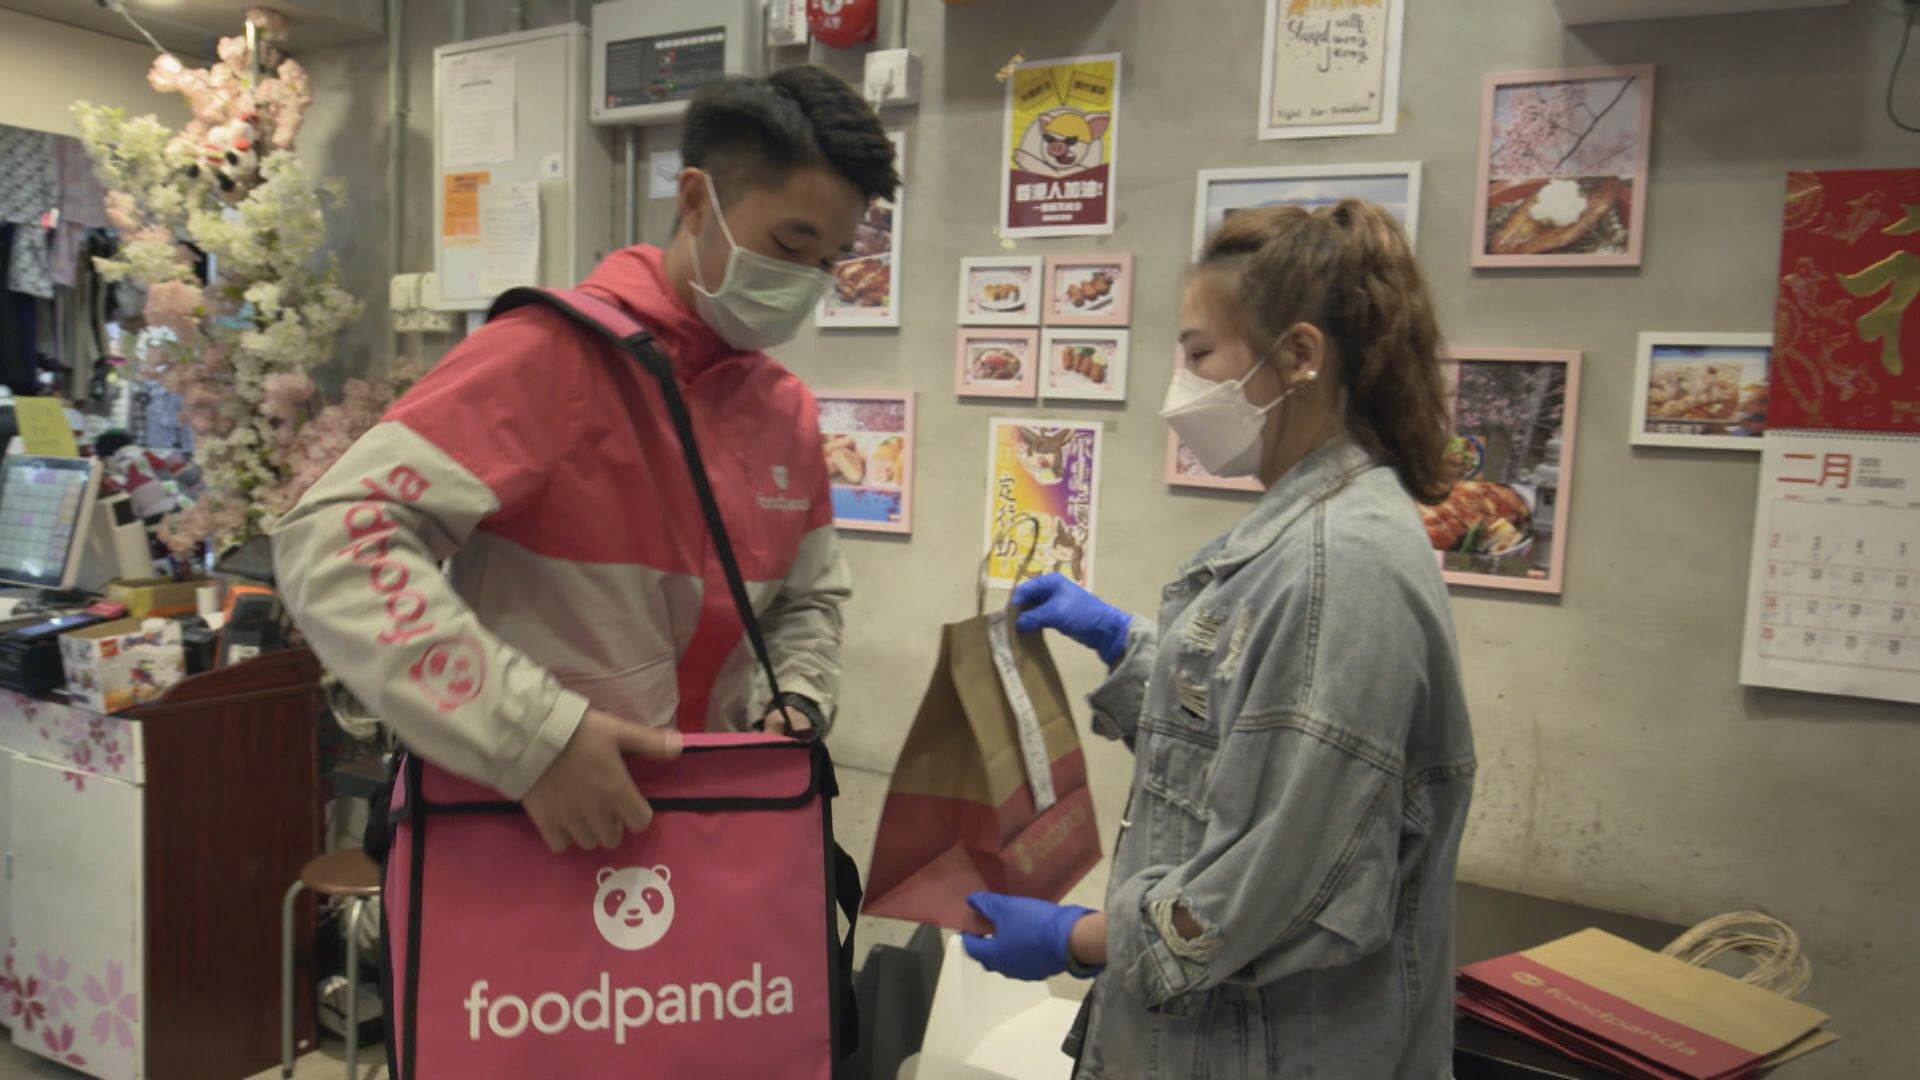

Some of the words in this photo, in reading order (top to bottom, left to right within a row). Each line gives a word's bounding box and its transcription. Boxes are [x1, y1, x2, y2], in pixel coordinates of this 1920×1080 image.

[1776, 452, 1853, 490] 二月
[463, 962, 794, 1045] foodpanda
[1545, 987, 1698, 1056] foodpanda
